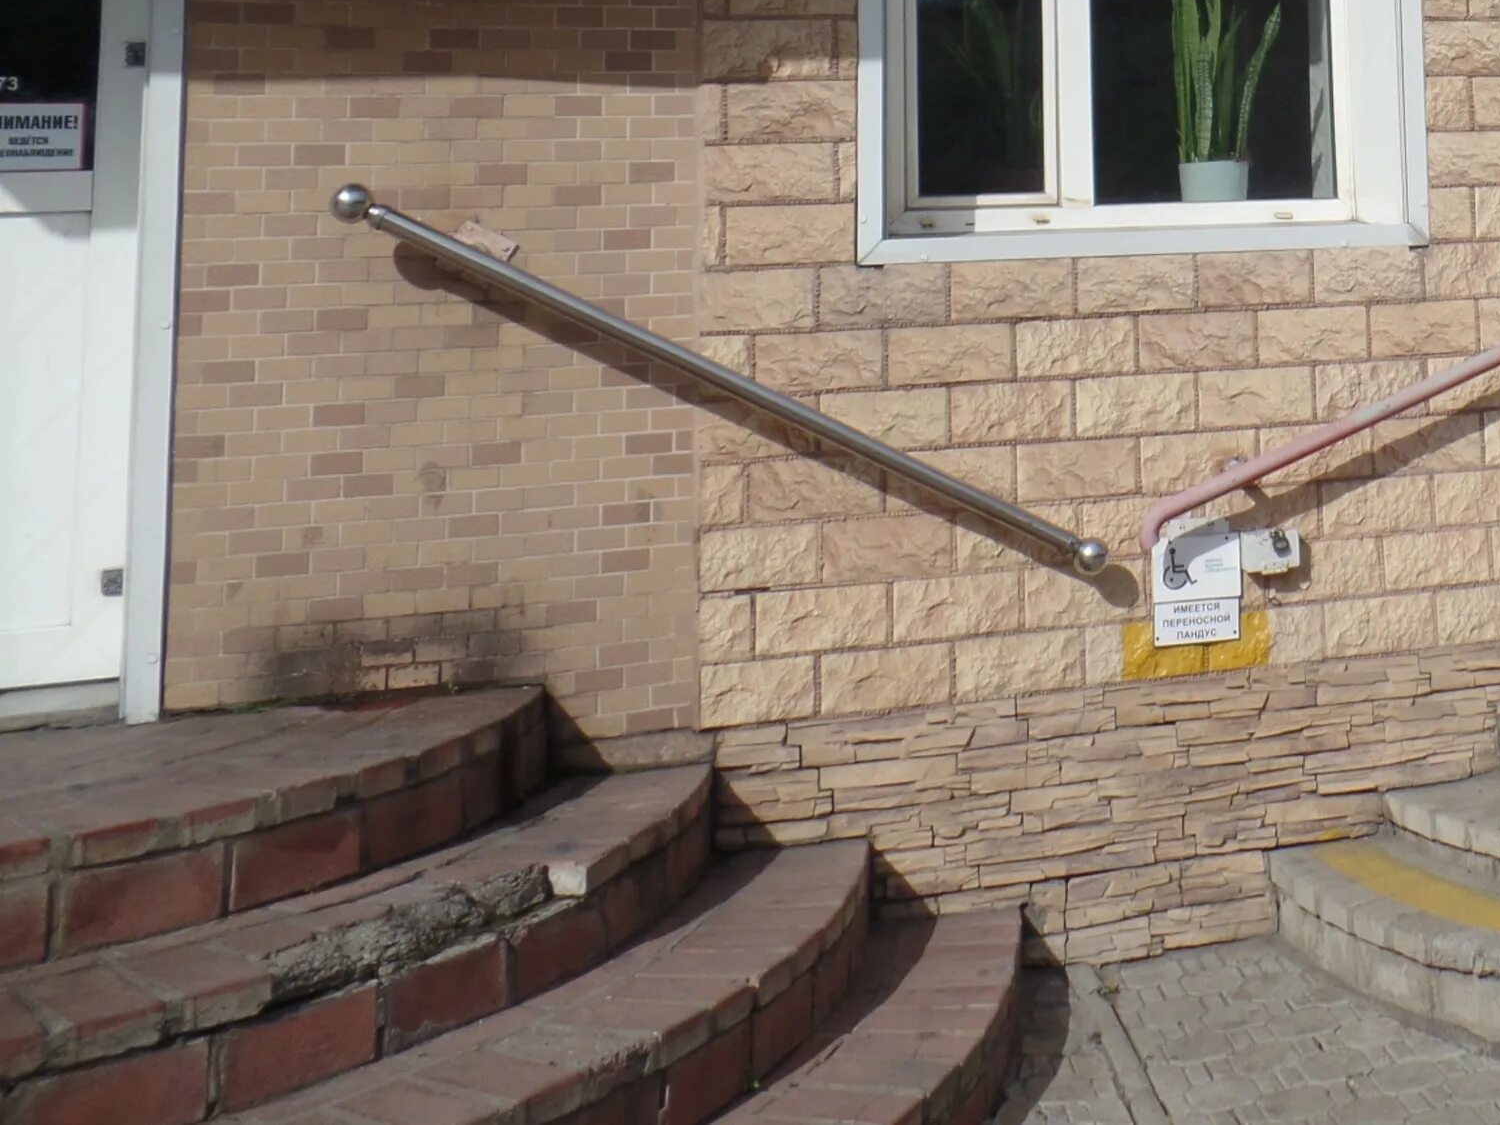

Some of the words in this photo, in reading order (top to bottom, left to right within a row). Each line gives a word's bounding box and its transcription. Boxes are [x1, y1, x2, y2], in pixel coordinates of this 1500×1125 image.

[1173, 602, 1220, 614] ИМЕЕТСЯ
[1162, 613, 1231, 628] ПЕРЕНОСНОЙ
[1176, 628, 1217, 640] ПАНДУС
